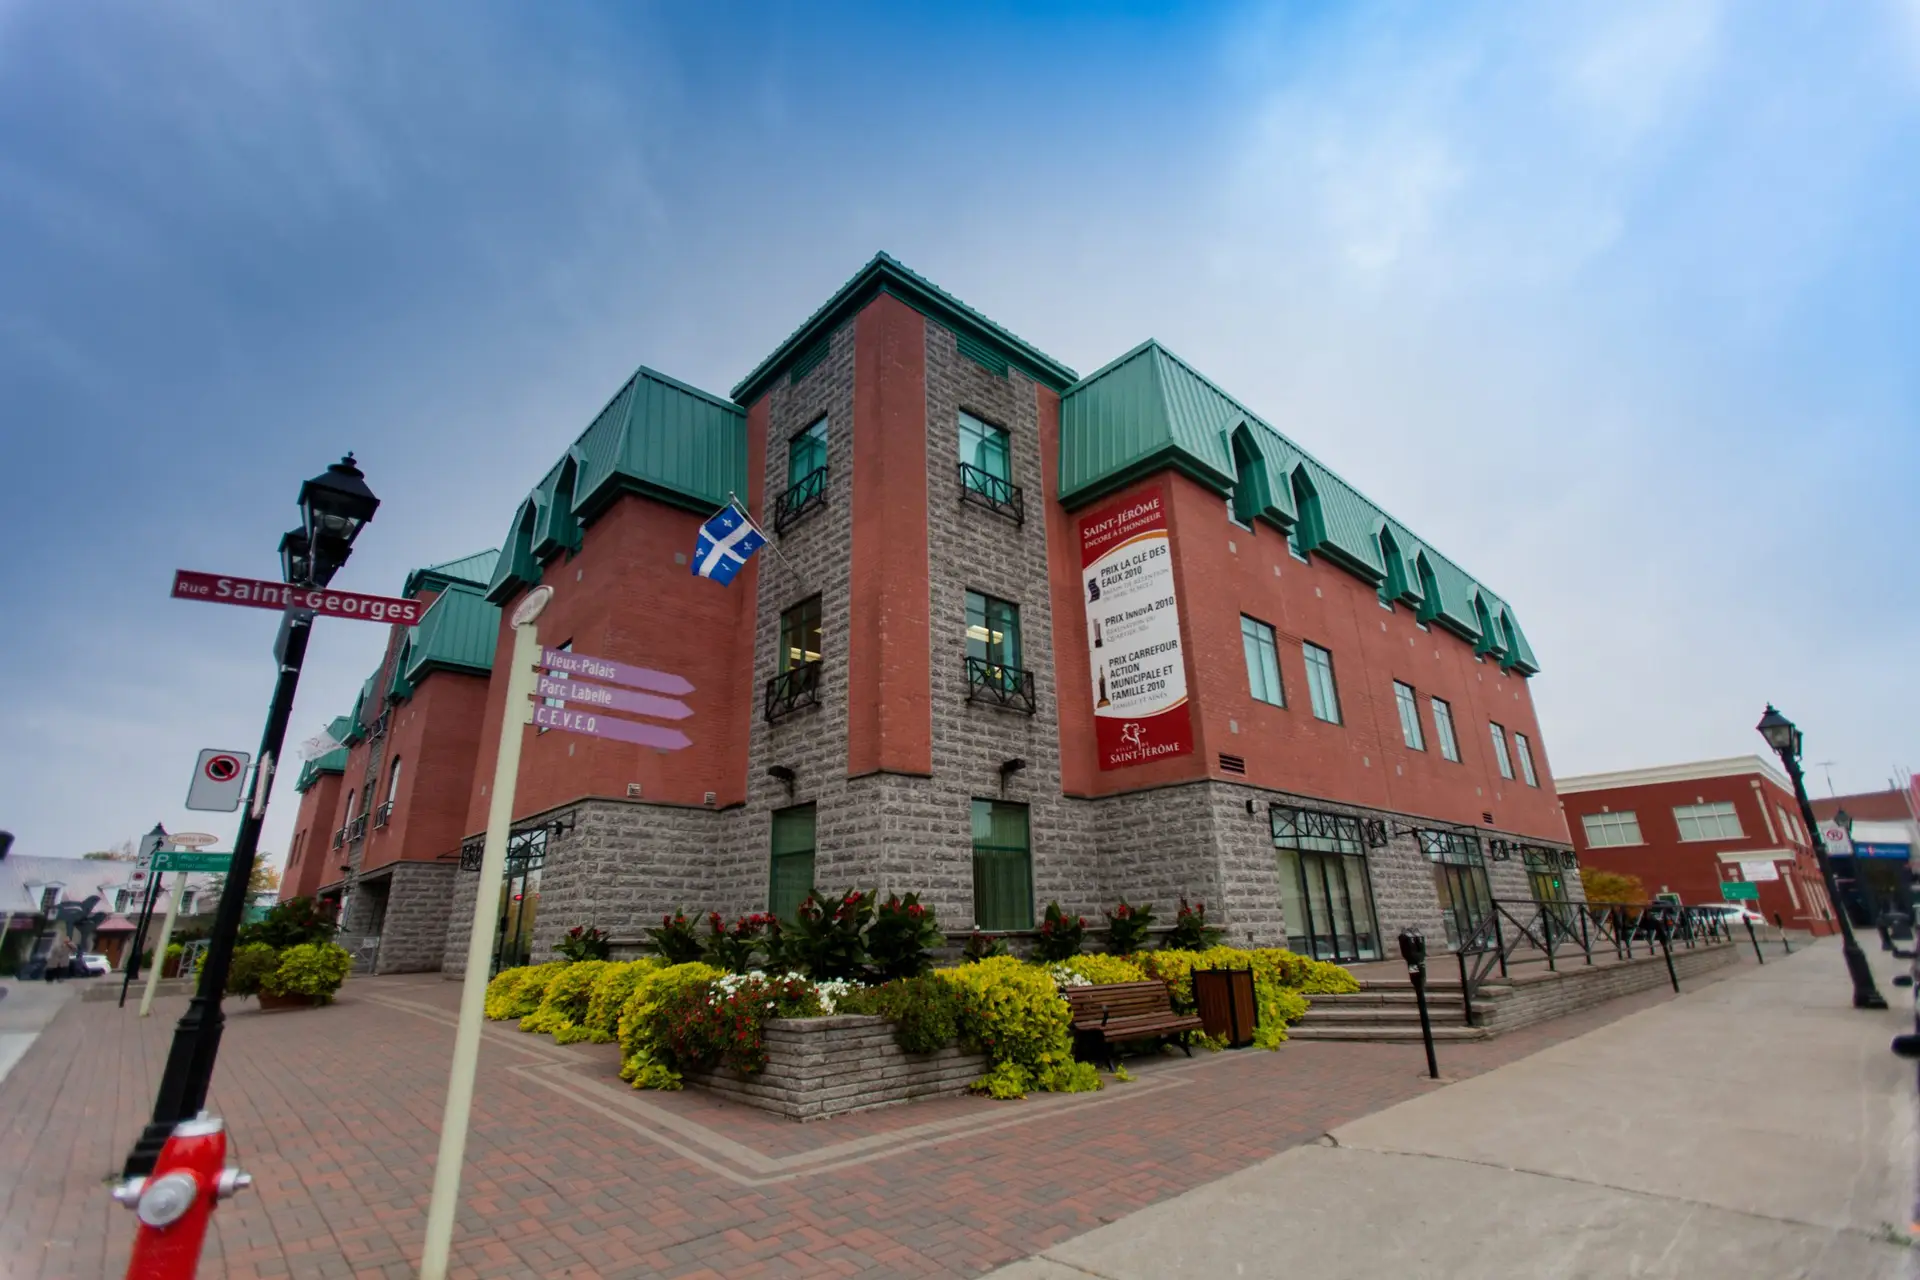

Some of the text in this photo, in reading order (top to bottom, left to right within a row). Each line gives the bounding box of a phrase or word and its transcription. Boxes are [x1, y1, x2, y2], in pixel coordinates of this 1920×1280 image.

[1084, 498, 1160, 539] SAINT-JÉRÔME
[1101, 563, 1119, 577] PRIX
[1120, 559, 1131, 570] LA
[1149, 545, 1166, 559] DES
[1102, 565, 1142, 588] EAUX 2010
[178, 579, 416, 620] Rue Saint-Georges
[1105, 613, 1124, 627] PRIX
[1155, 596, 1174, 611] 2010
[545, 652, 617, 679] Vieux-Palais
[1109, 639, 1178, 668] PRIX CARREFOUR
[1110, 663, 1140, 679] ACTION
[1111, 664, 1173, 690] MUNICIPALE ET
[540, 679, 612, 705] Parc Labelle
[1112, 679, 1166, 702] FAMILLE 2010
